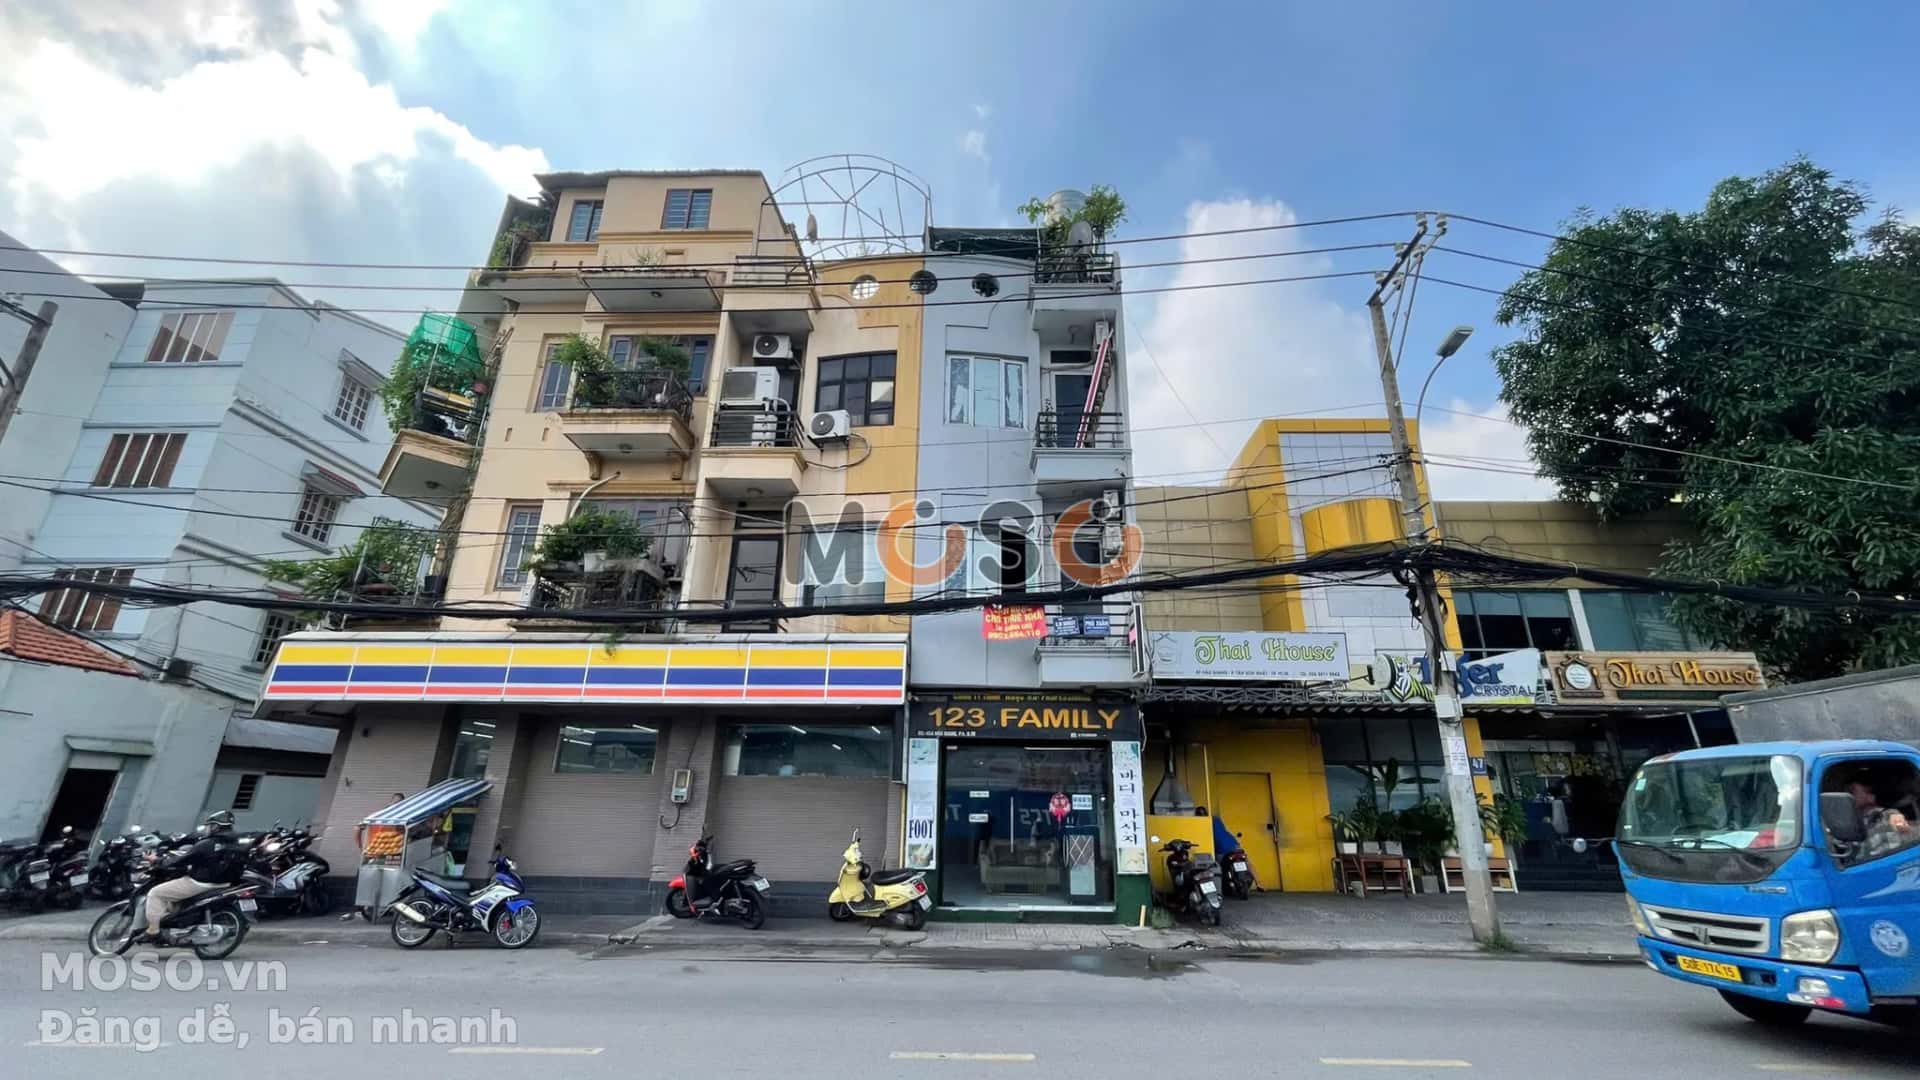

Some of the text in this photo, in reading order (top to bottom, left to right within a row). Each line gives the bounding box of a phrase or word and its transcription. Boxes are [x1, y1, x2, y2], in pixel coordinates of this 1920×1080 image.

[1194, 635, 1335, 664] Thai House
[1605, 657, 1665, 688] Thai
[1671, 658, 1759, 686] House
[1474, 683, 1536, 697] CRYSTAL
[928, 706, 1120, 729] 123 FAMILY
[908, 819, 934, 839] FOOT
[1119, 808, 1142, 845] 마사지
